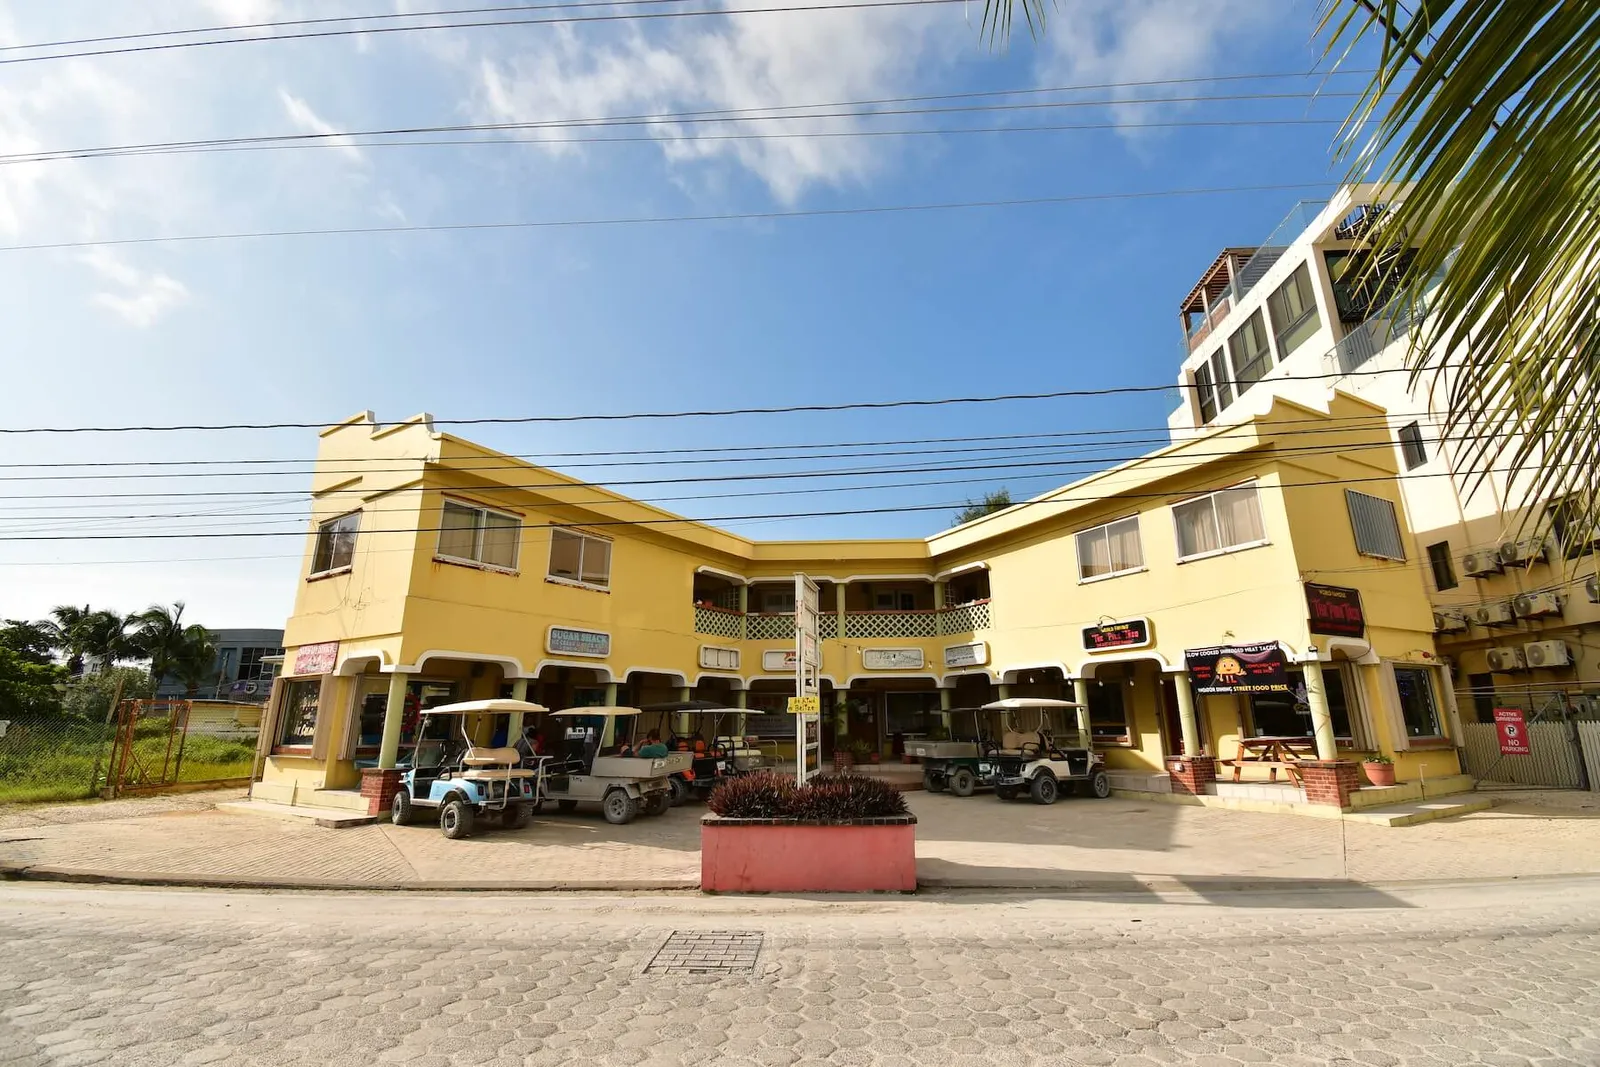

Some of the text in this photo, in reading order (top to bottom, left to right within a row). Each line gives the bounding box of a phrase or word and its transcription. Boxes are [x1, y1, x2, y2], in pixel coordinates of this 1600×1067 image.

[552, 630, 608, 645] SUGAR SHACK
[1219, 647, 1244, 655] SHREDDED
[1259, 643, 1278, 651] TACOS
[1508, 739, 1520, 747] NO
[1501, 745, 1529, 753] PARKING
